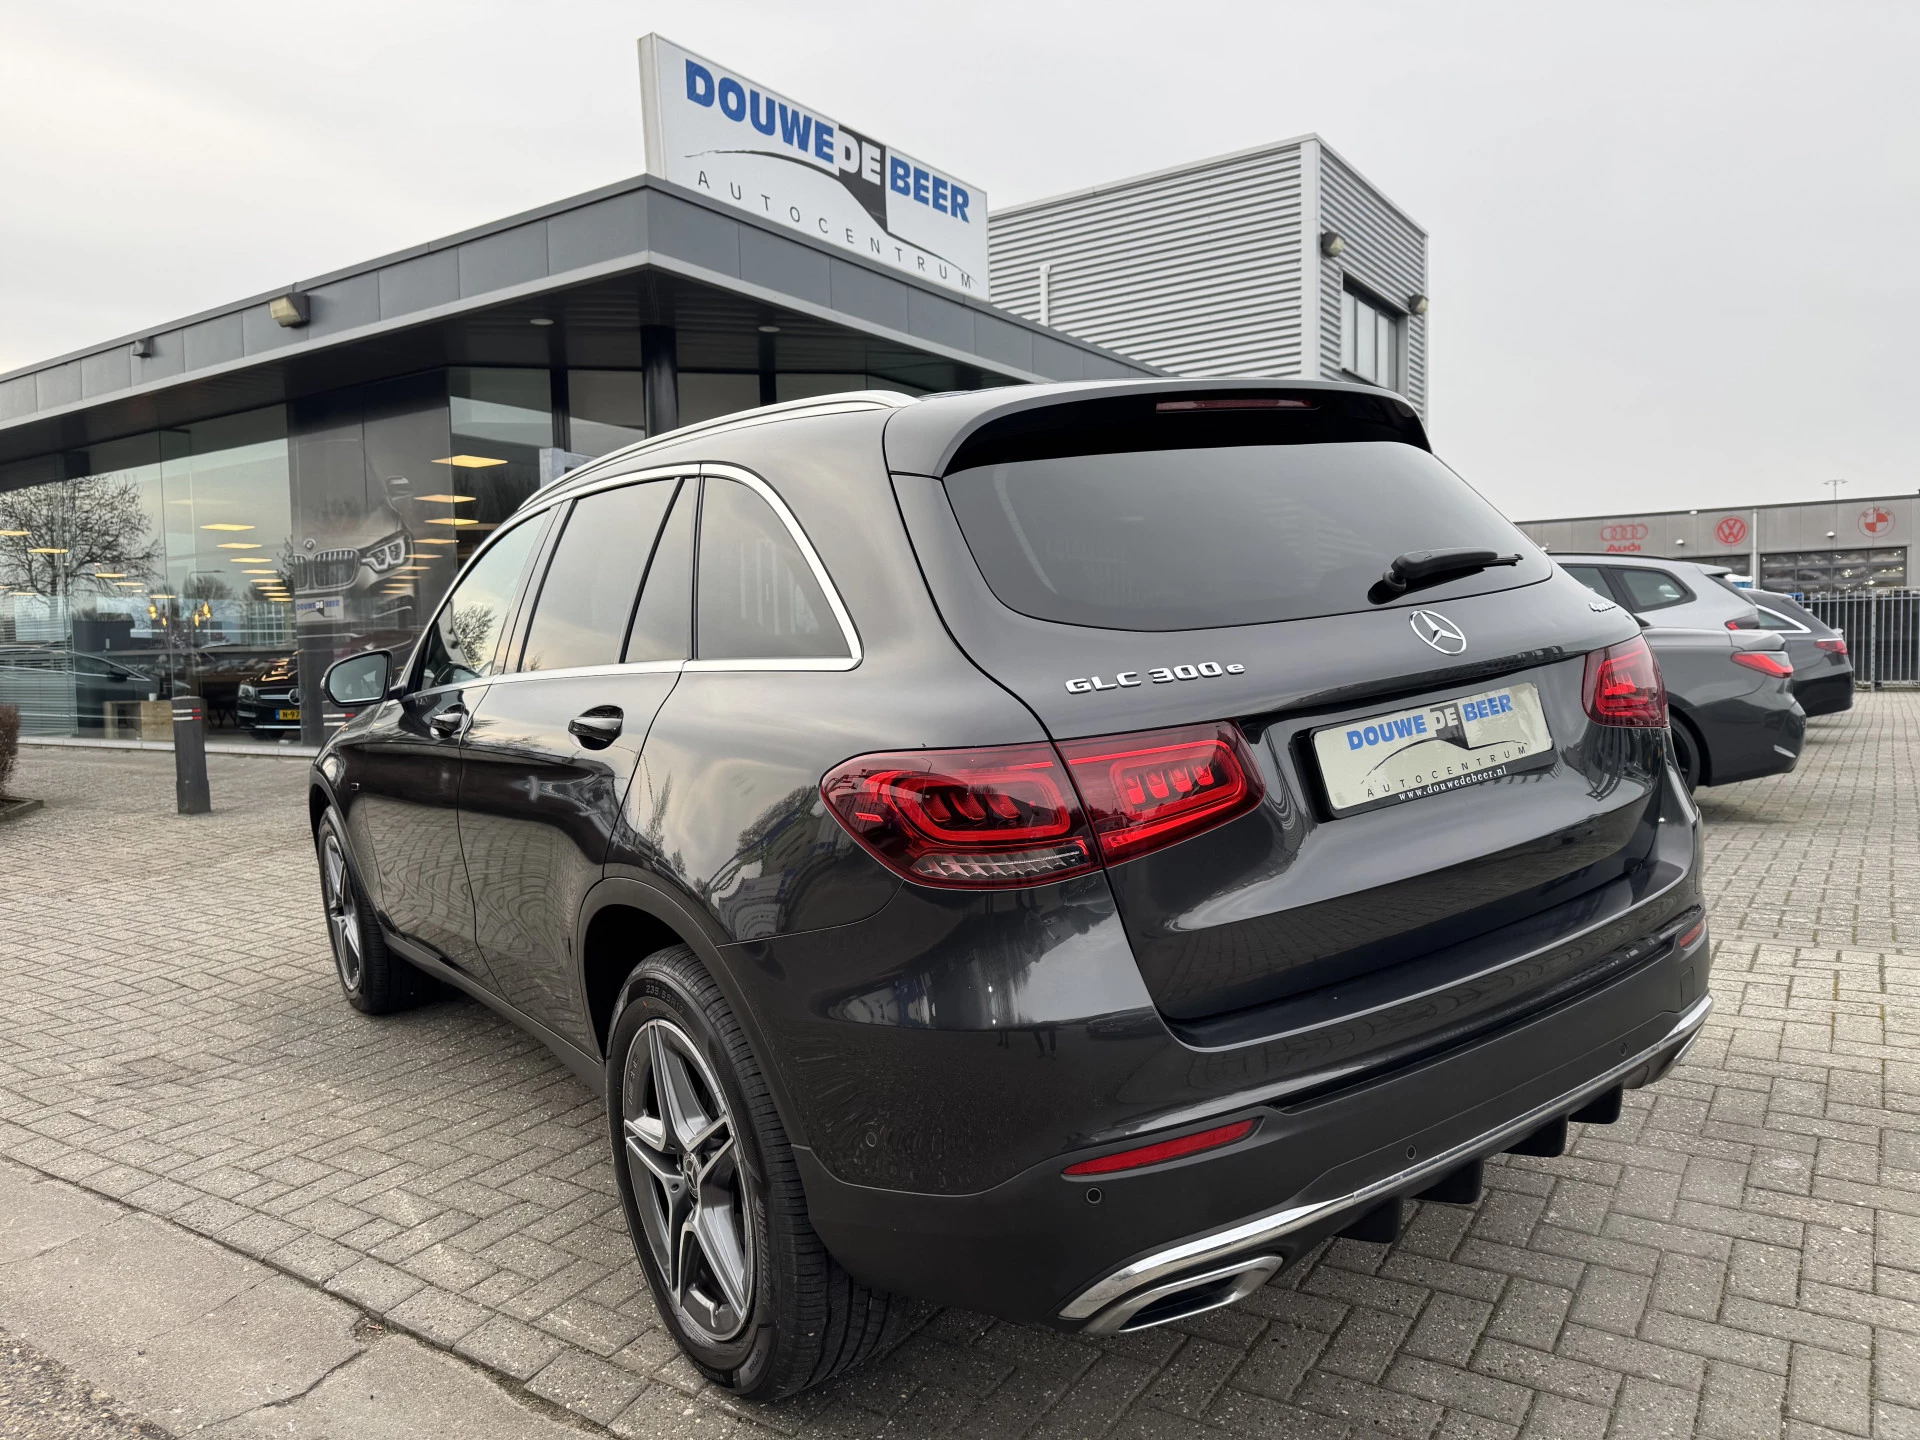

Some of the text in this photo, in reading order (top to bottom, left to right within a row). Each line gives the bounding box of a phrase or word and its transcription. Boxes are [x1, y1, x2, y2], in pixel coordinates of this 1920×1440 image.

[685, 58, 970, 223] DOUWE DE BEER
[698, 170, 971, 289] AUTOCENTRUM
[1065, 671, 1142, 694] GLC
[1346, 694, 1514, 751] DOUWE DE BEER
[1367, 746, 1526, 798] AUTOCENTRUM
[1398, 765, 1508, 801] www.douwedebeer.nl
